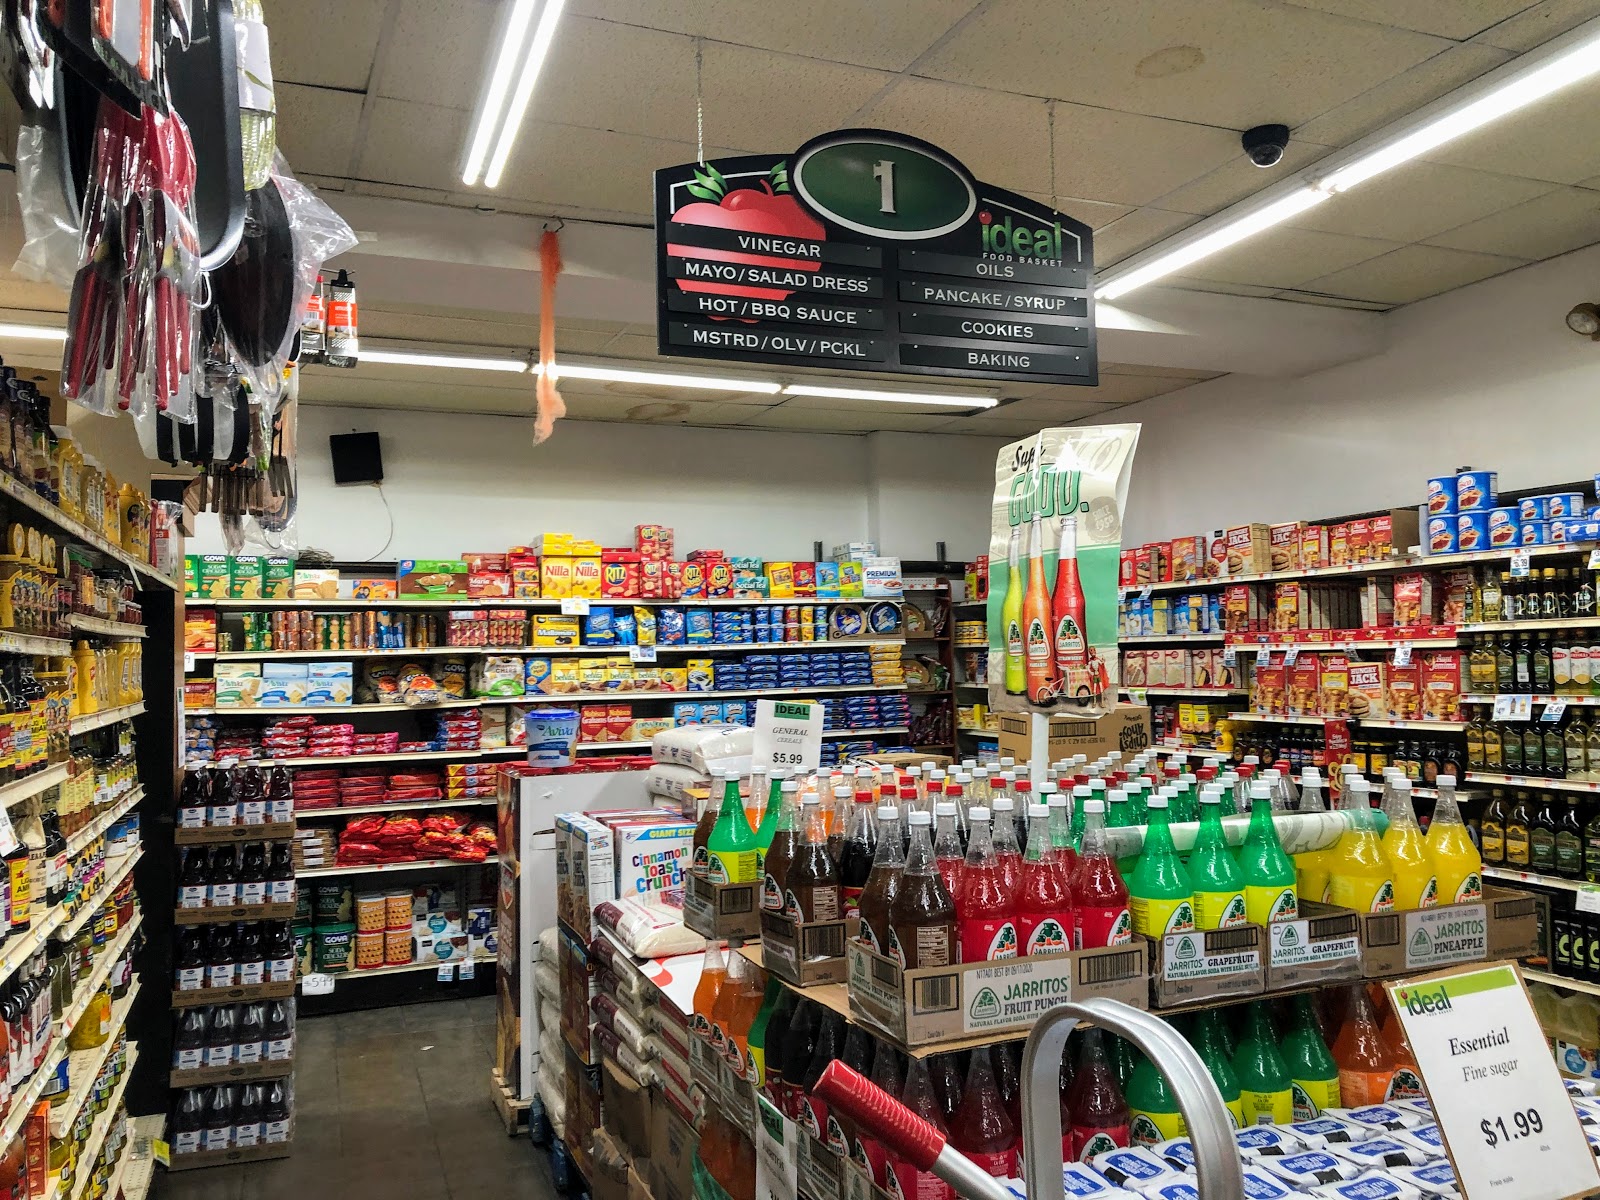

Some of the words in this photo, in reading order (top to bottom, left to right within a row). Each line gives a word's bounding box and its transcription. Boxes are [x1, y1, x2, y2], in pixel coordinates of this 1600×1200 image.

[873, 160, 896, 214] 1
[979, 211, 1062, 259] ideal
[738, 236, 821, 258] VINEGAR
[982, 252, 1014, 262] FOOD
[1019, 257, 1063, 267] BASKET
[976, 263, 1014, 278] OILS
[812, 276, 868, 293] DRESS
[797, 307, 857, 324] SAUCE
[961, 321, 1034, 338] COOKIES
[968, 353, 1030, 368] BAKING
[1228, 534, 1250, 544] JACK
[1272, 534, 1290, 543] JAC
[546, 566, 569, 576] Nilla
[575, 566, 598, 576] Nilla
[606, 568, 625, 581] RITZ
[686, 568, 700, 578] RITZ
[713, 569, 727, 579] RITZ
[1350, 673, 1378, 684] JACK
[775, 705, 809, 715] IDEAL
[542, 726, 573, 736] Aviva
[773, 727, 808, 736] GENERAL
[773, 752, 802, 764] $5.99
[649, 829, 676, 839] GIANT
[632, 846, 688, 867] Cinnamon
[643, 861, 679, 878] Toast
[1434, 920, 1484, 939] JARRITOS
[325, 935, 348, 943] GOYA
[1434, 937, 1483, 954] PINEAPPLE
[1273, 947, 1305, 958] JARRITOS
[1312, 941, 1354, 953] GRAPEFRUIT
[1168, 959, 1203, 971] JARRITOS
[1208, 955, 1254, 966] GRAPEFRUIT
[994, 967, 1004, 977] BEST
[1004, 977, 1068, 1000] JARRITOS
[1004, 1001, 1032, 1015] FRUIT
[1400, 985, 1452, 1016] ideal
[1449, 1027, 1510, 1056] Essential
[1462, 1065, 1488, 1082] Fine
[1489, 1059, 1519, 1077] sugar
[1481, 1108, 1543, 1149] $1.99
